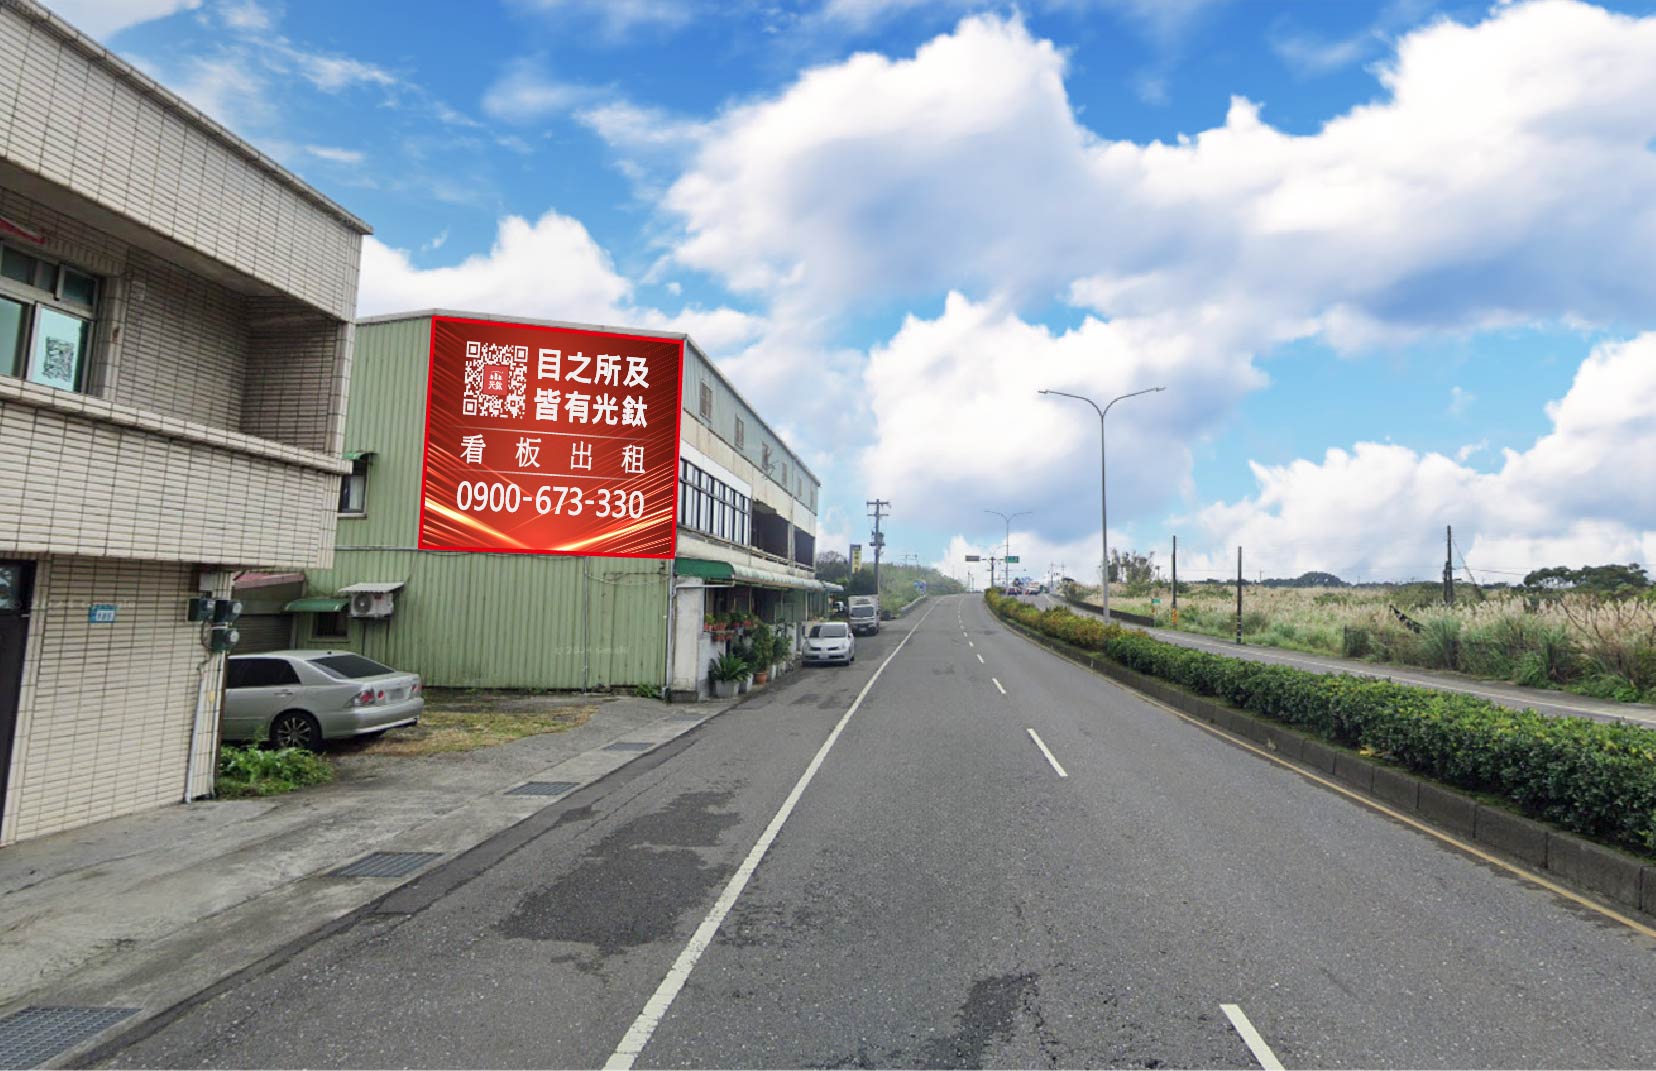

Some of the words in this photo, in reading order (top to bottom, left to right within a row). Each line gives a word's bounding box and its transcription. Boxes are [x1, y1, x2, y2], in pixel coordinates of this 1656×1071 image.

[537, 348, 650, 389] 目之所及
[534, 387, 648, 428] 皆有光鈦
[460, 433, 646, 474] 看板出租
[456, 480, 645, 519] 0900-673-330
